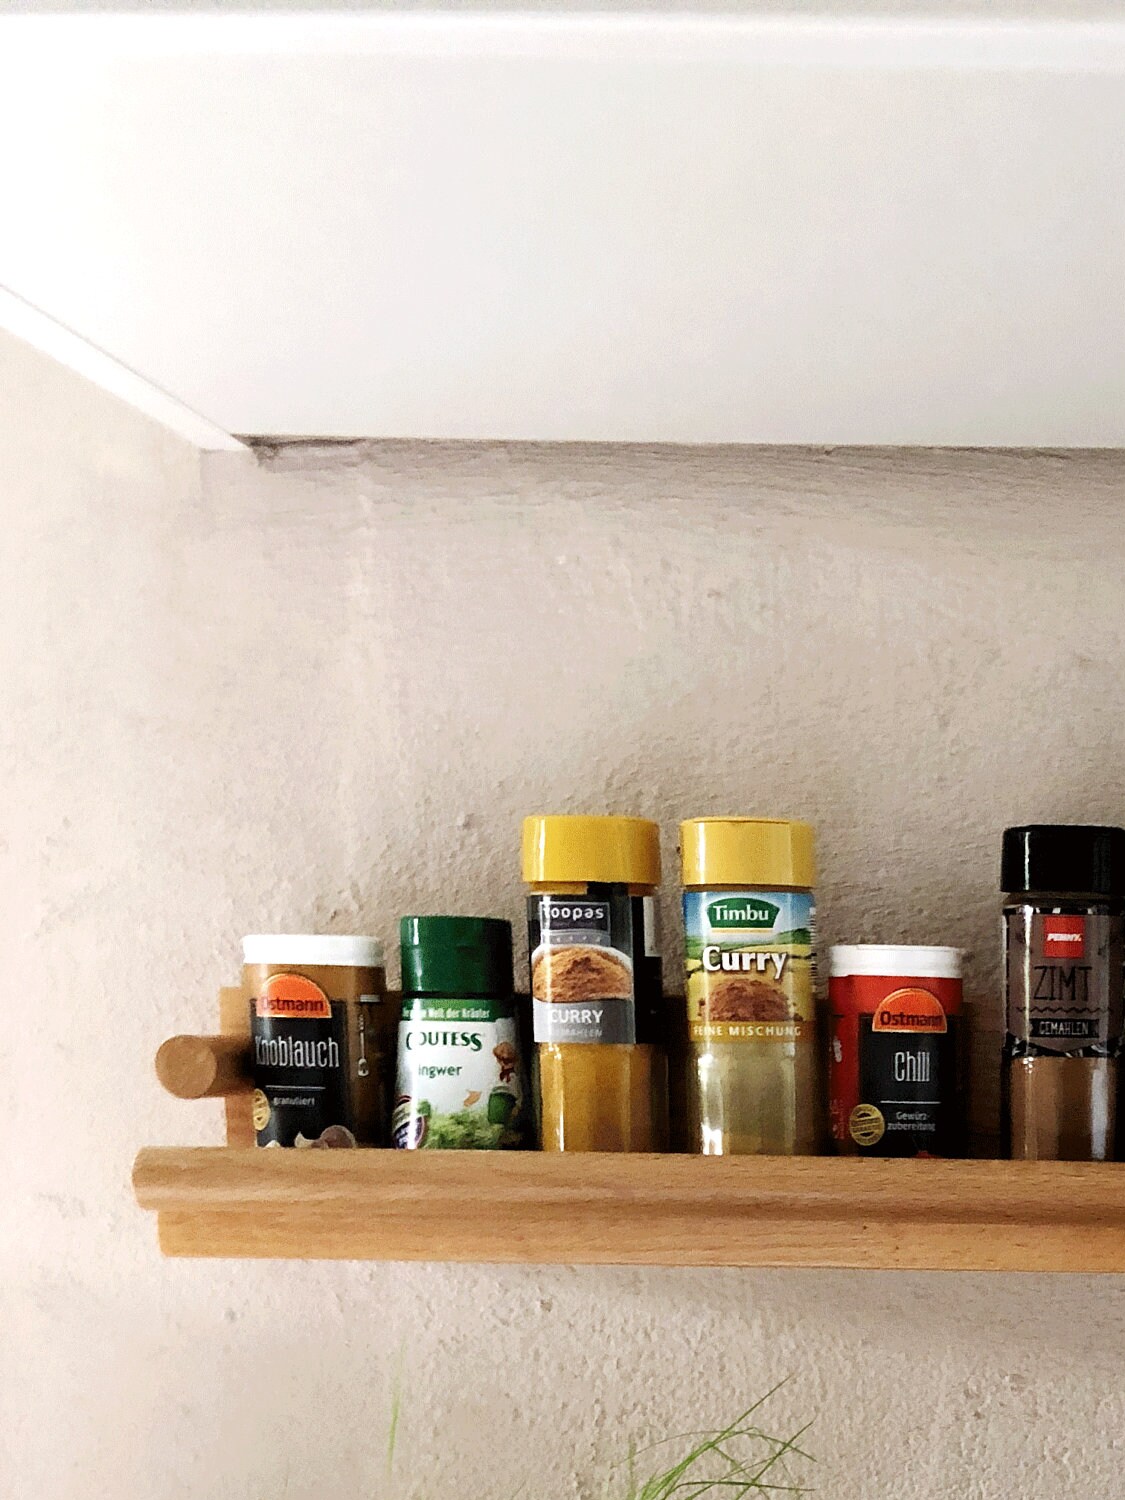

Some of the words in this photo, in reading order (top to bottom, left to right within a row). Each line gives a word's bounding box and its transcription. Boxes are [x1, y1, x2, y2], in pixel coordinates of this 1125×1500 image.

[711, 904, 769, 922] Timbu
[702, 945, 789, 981] Curry
[1032, 964, 1093, 1002] ZIMT
[548, 1009, 604, 1024] CURRY
[880, 1011, 943, 1026] Ostmann
[728, 1024, 802, 1037] MISCHUNG
[1039, 1020, 1089, 1035] GEMAHLEN
[255, 1035, 340, 1068] Knoblauch
